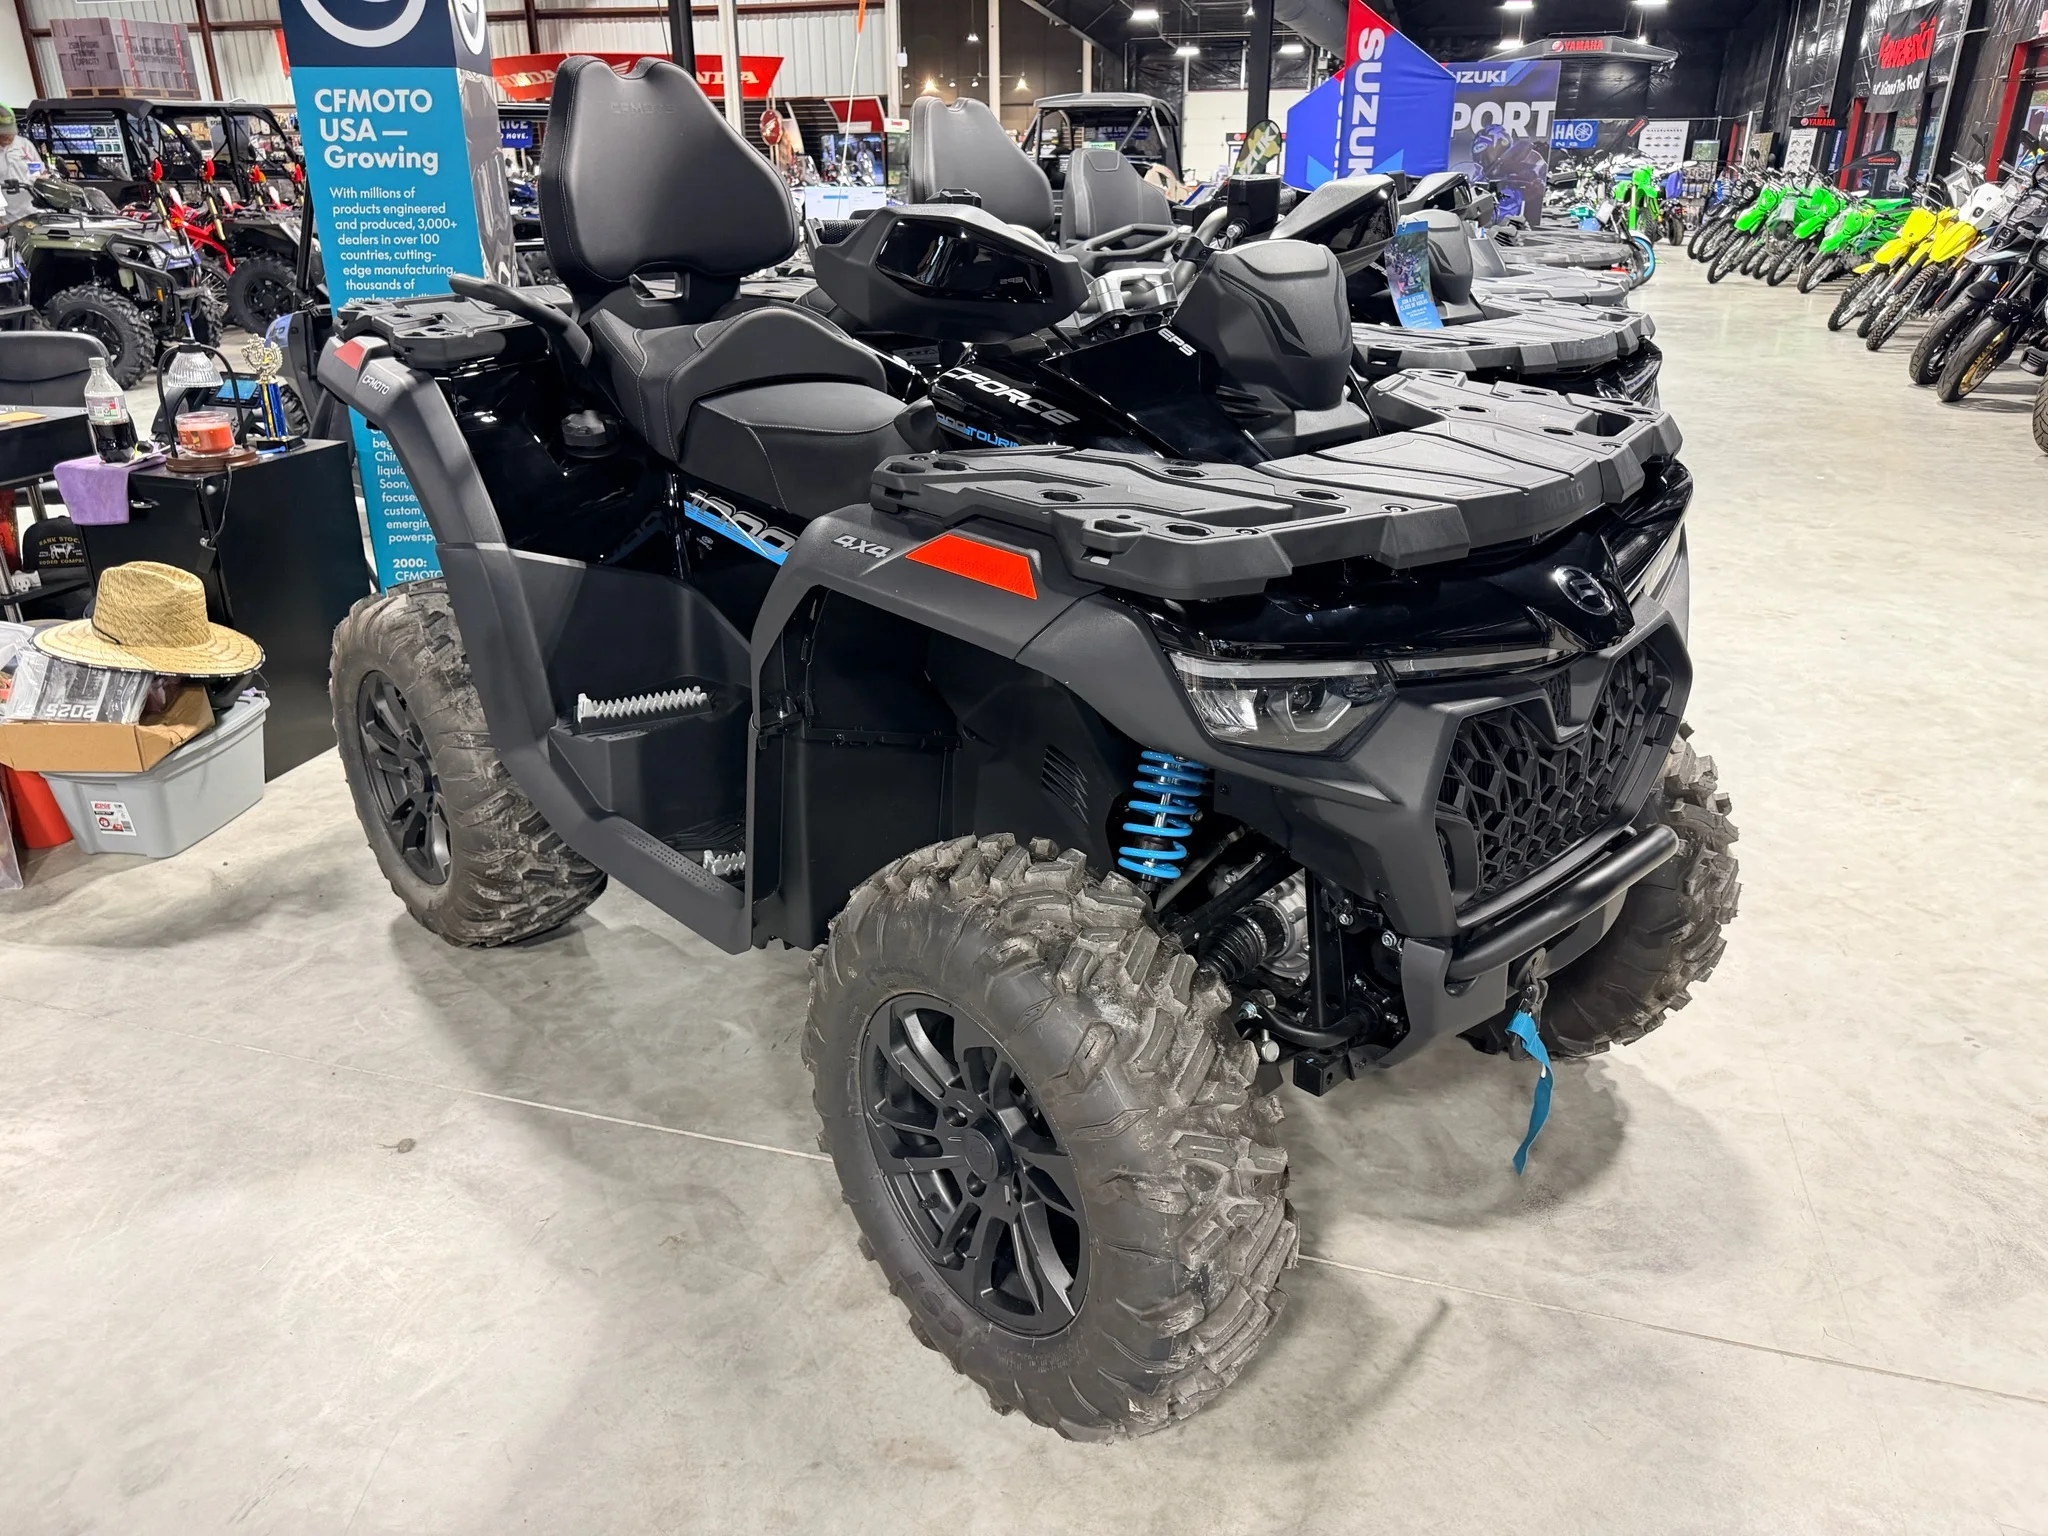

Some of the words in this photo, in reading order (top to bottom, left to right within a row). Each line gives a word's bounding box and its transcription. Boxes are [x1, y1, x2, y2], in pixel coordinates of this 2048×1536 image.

[1564, 40, 1604, 51] YAMAHA
[314, 89, 432, 113] CFMOTO
[1450, 101, 1557, 137] PORT
[319, 118, 377, 142] USA
[324, 145, 439, 175] Growing
[329, 187, 357, 199] With
[360, 187, 401, 199] millions
[403, 187, 416, 199] of
[333, 203, 381, 217] products
[383, 202, 446, 217] engineered
[335, 218, 357, 230] and
[360, 218, 416, 232] produced,
[417, 218, 457, 230] 3,000+
[337, 233, 379, 245] dealers
[381, 234, 391, 245] in
[393, 236, 418, 245] over
[420, 233, 440, 245] 100
[340, 250, 392, 261] countries,
[394, 250, 437, 263] cutting-
[343, 264, 372, 278] edge
[374, 263, 456, 277] manufacturing,
[345, 279, 401, 290] thousands
[403, 278, 415, 290] of
[1157, 327, 1197, 357] EPS
[361, 374, 391, 396] CFMOTO
[947, 367, 1080, 426] CFORCE
[379, 478, 409, 489] Soon,
[382, 491, 418, 503] focuse
[384, 507, 420, 516] custom
[386, 520, 431, 532] emergin
[689, 489, 799, 556] 1000
[833, 534, 892, 559] 4X4
[393, 558, 427, 569] 2000:
